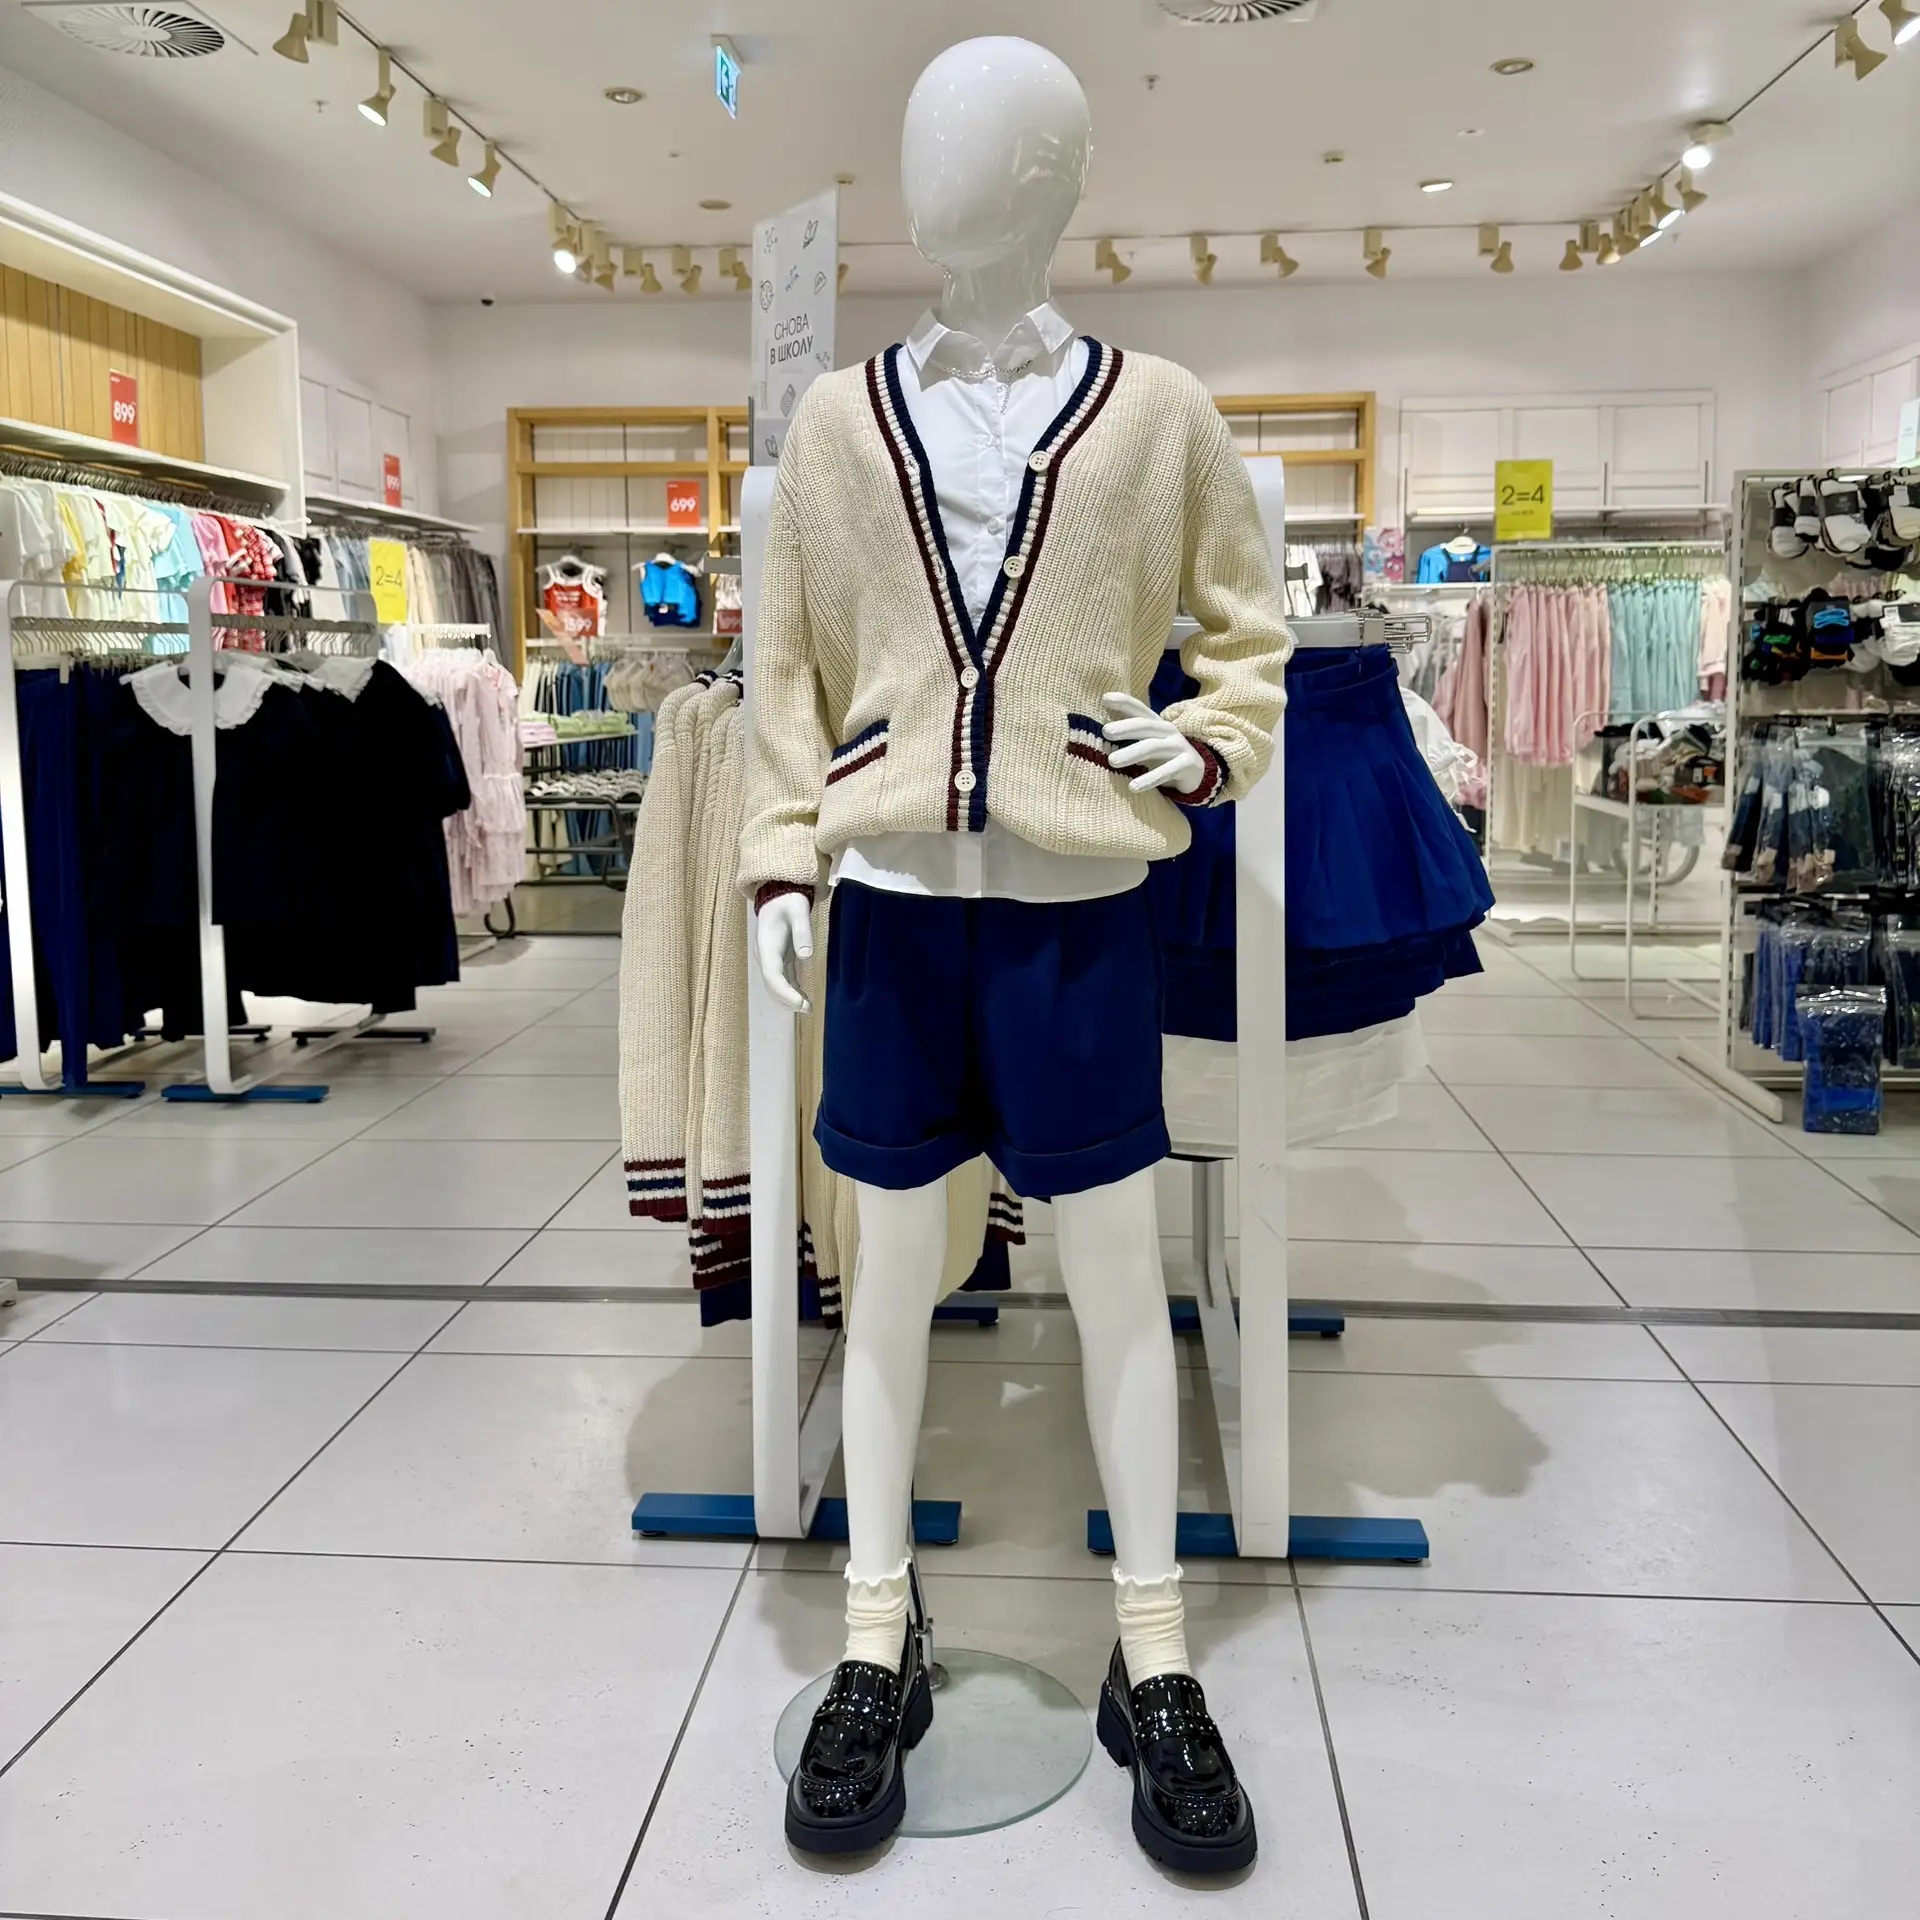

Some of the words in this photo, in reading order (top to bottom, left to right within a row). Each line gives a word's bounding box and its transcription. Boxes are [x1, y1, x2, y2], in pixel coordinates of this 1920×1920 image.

[774, 313, 809, 340] СНОВА
[770, 347, 776, 365] В
[778, 335, 813, 362] ШКОЛУ
[113, 400, 136, 425] 899
[670, 497, 697, 512] 699
[1502, 484, 1544, 505] 2=4
[375, 565, 402, 588] 2=4
